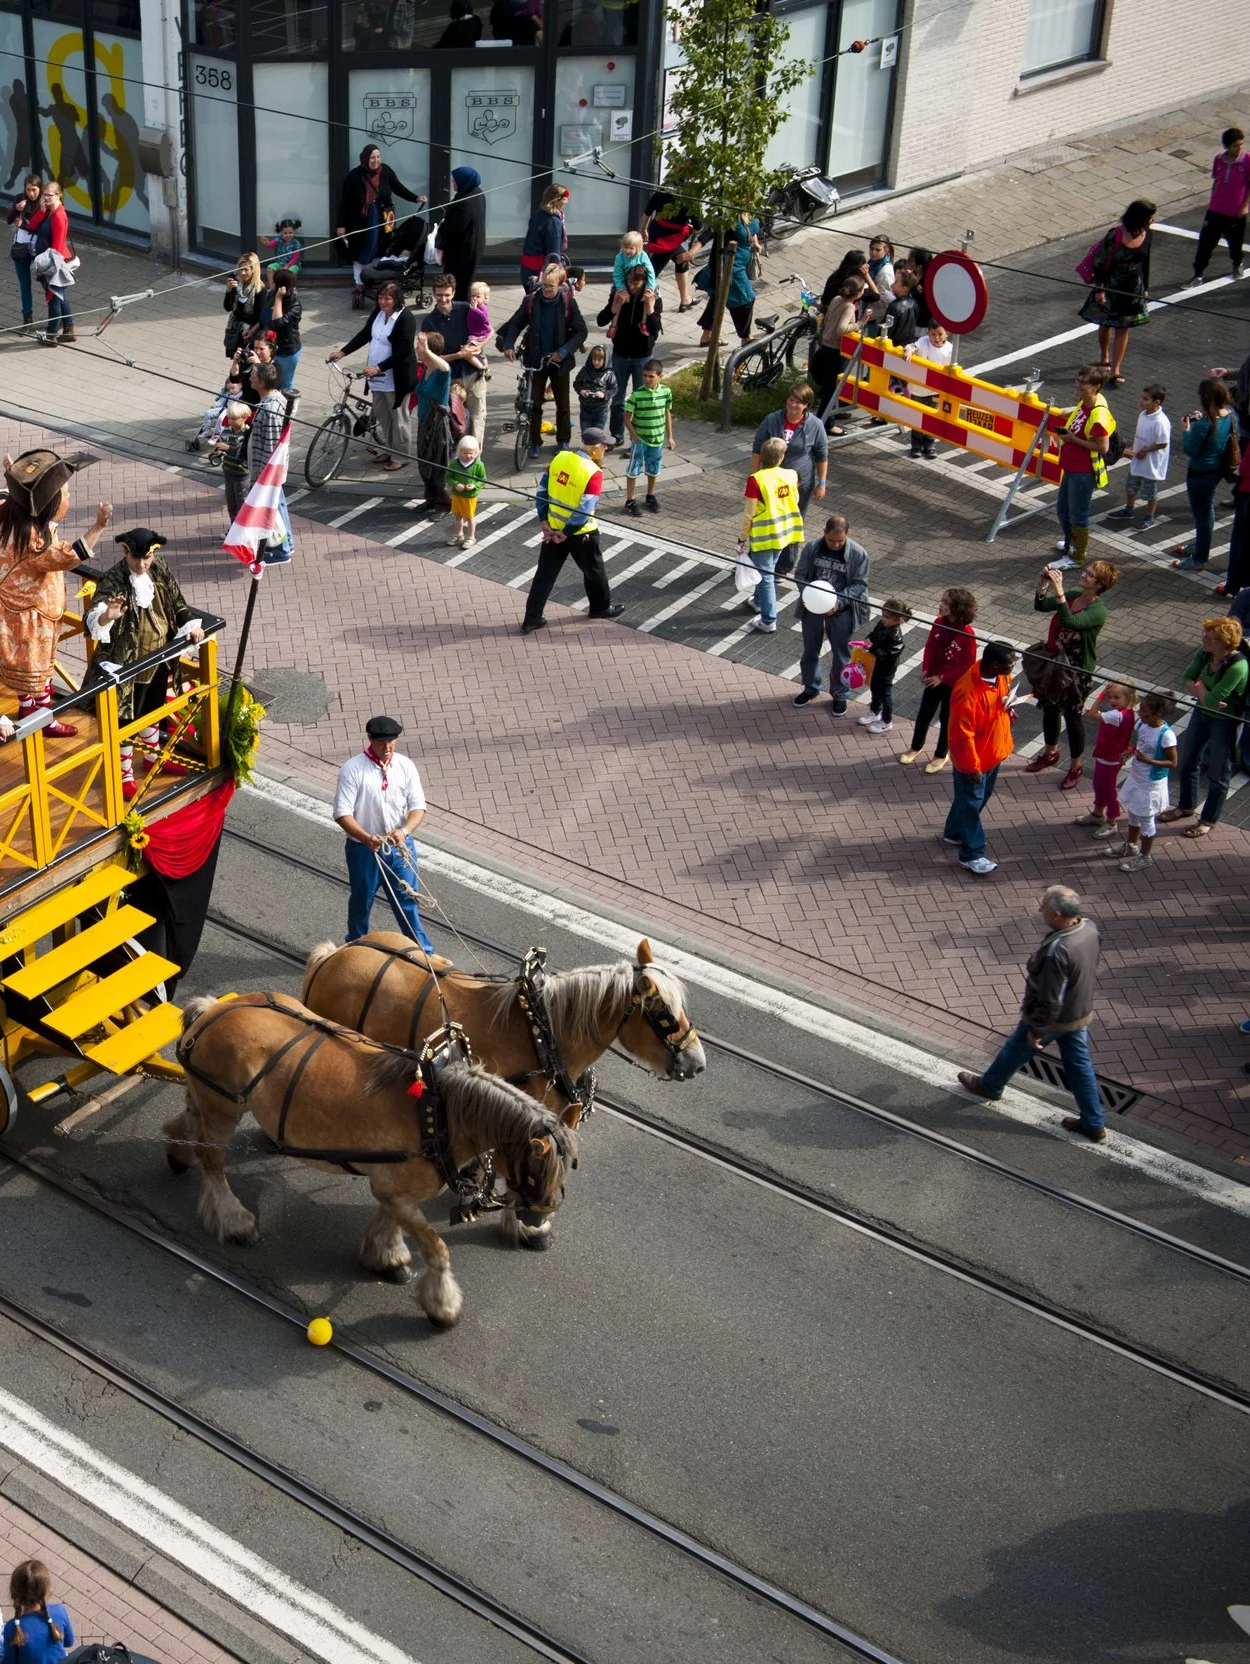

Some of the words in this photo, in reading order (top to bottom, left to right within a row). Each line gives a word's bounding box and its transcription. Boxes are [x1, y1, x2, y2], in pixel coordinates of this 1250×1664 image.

[195, 65, 232, 91] 358
[370, 99, 411, 107] BBS
[472, 97, 514, 106] BBS
[966, 408, 994, 424] REUZEN
